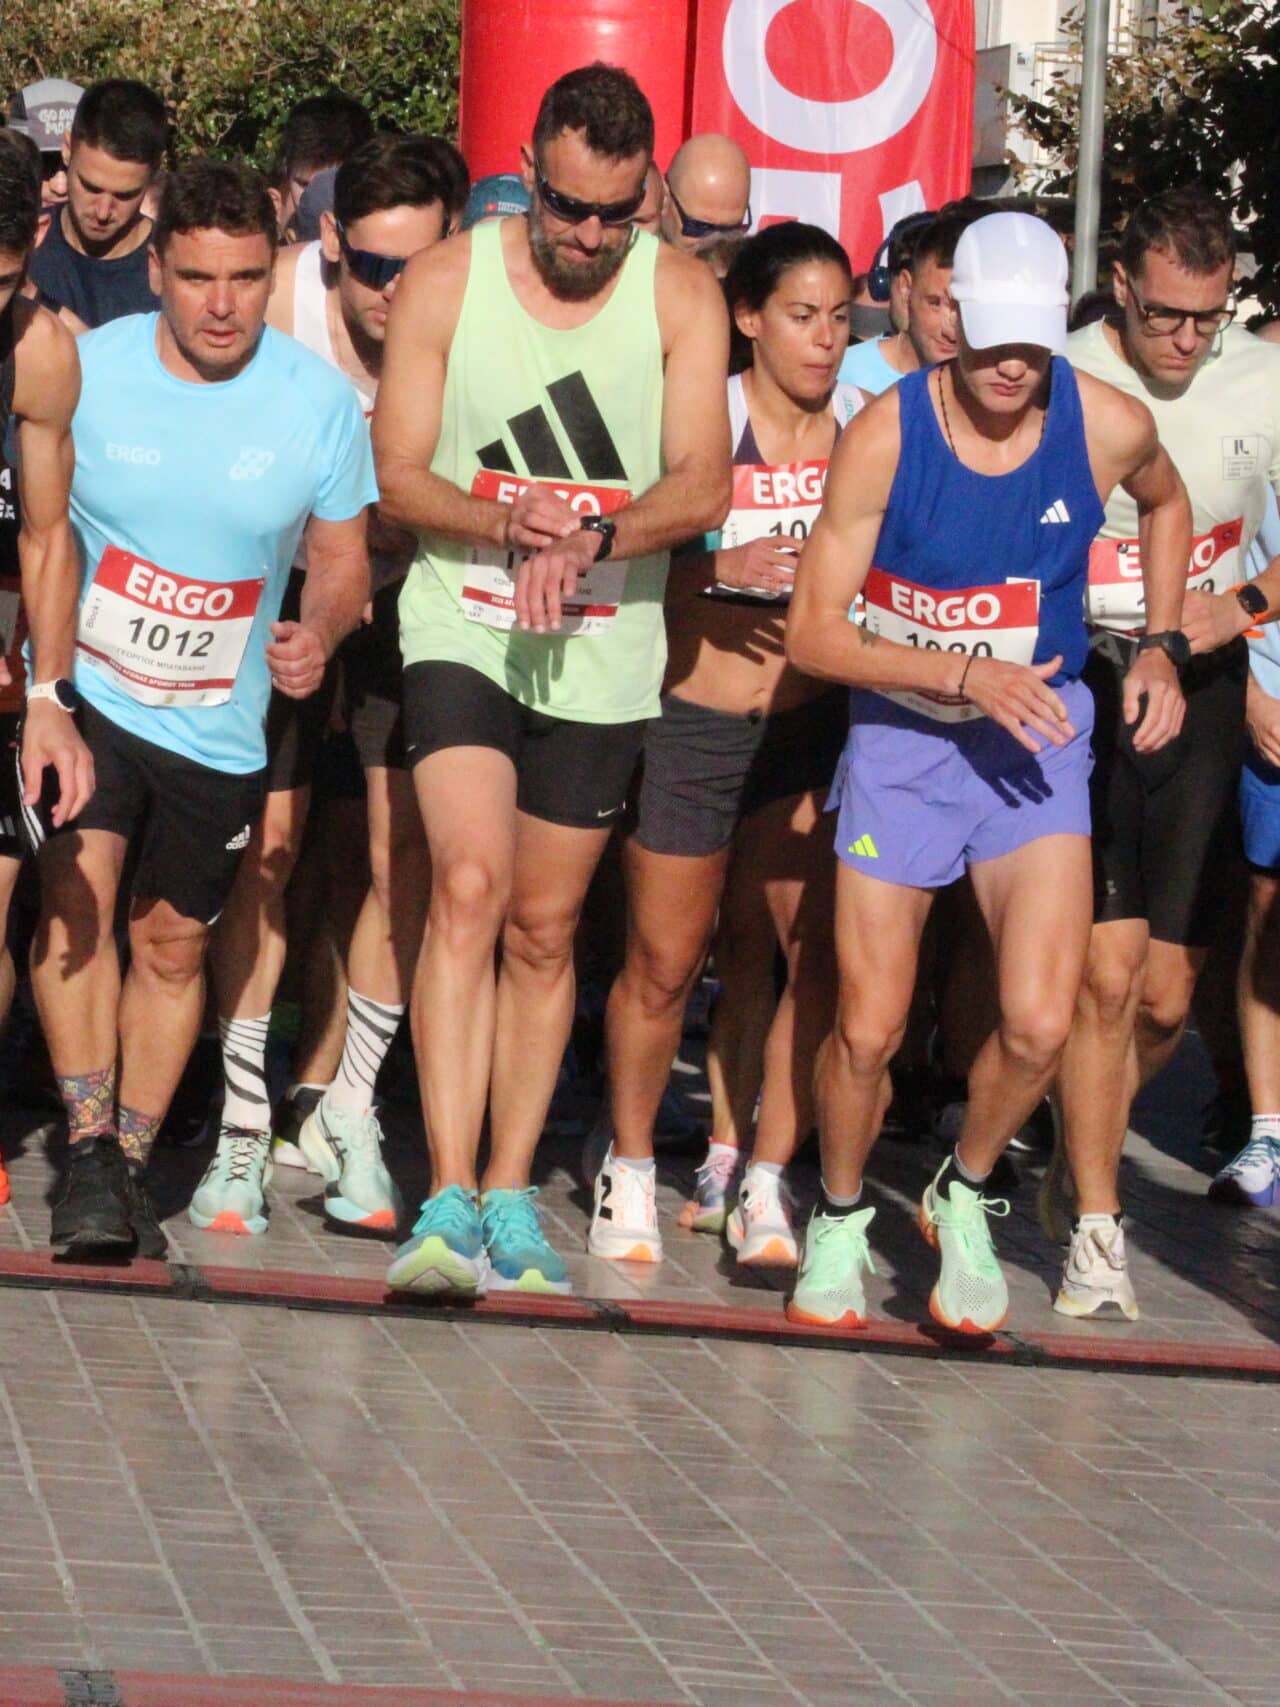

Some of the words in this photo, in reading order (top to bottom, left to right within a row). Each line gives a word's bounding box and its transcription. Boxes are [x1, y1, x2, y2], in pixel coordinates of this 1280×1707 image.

[106, 443, 161, 465] ERGO
[752, 467, 828, 505] ERG
[1118, 537, 1216, 577] EO
[125, 562, 235, 617] ERGO
[891, 581, 1001, 628] ERGO
[128, 616, 215, 658] 1012
